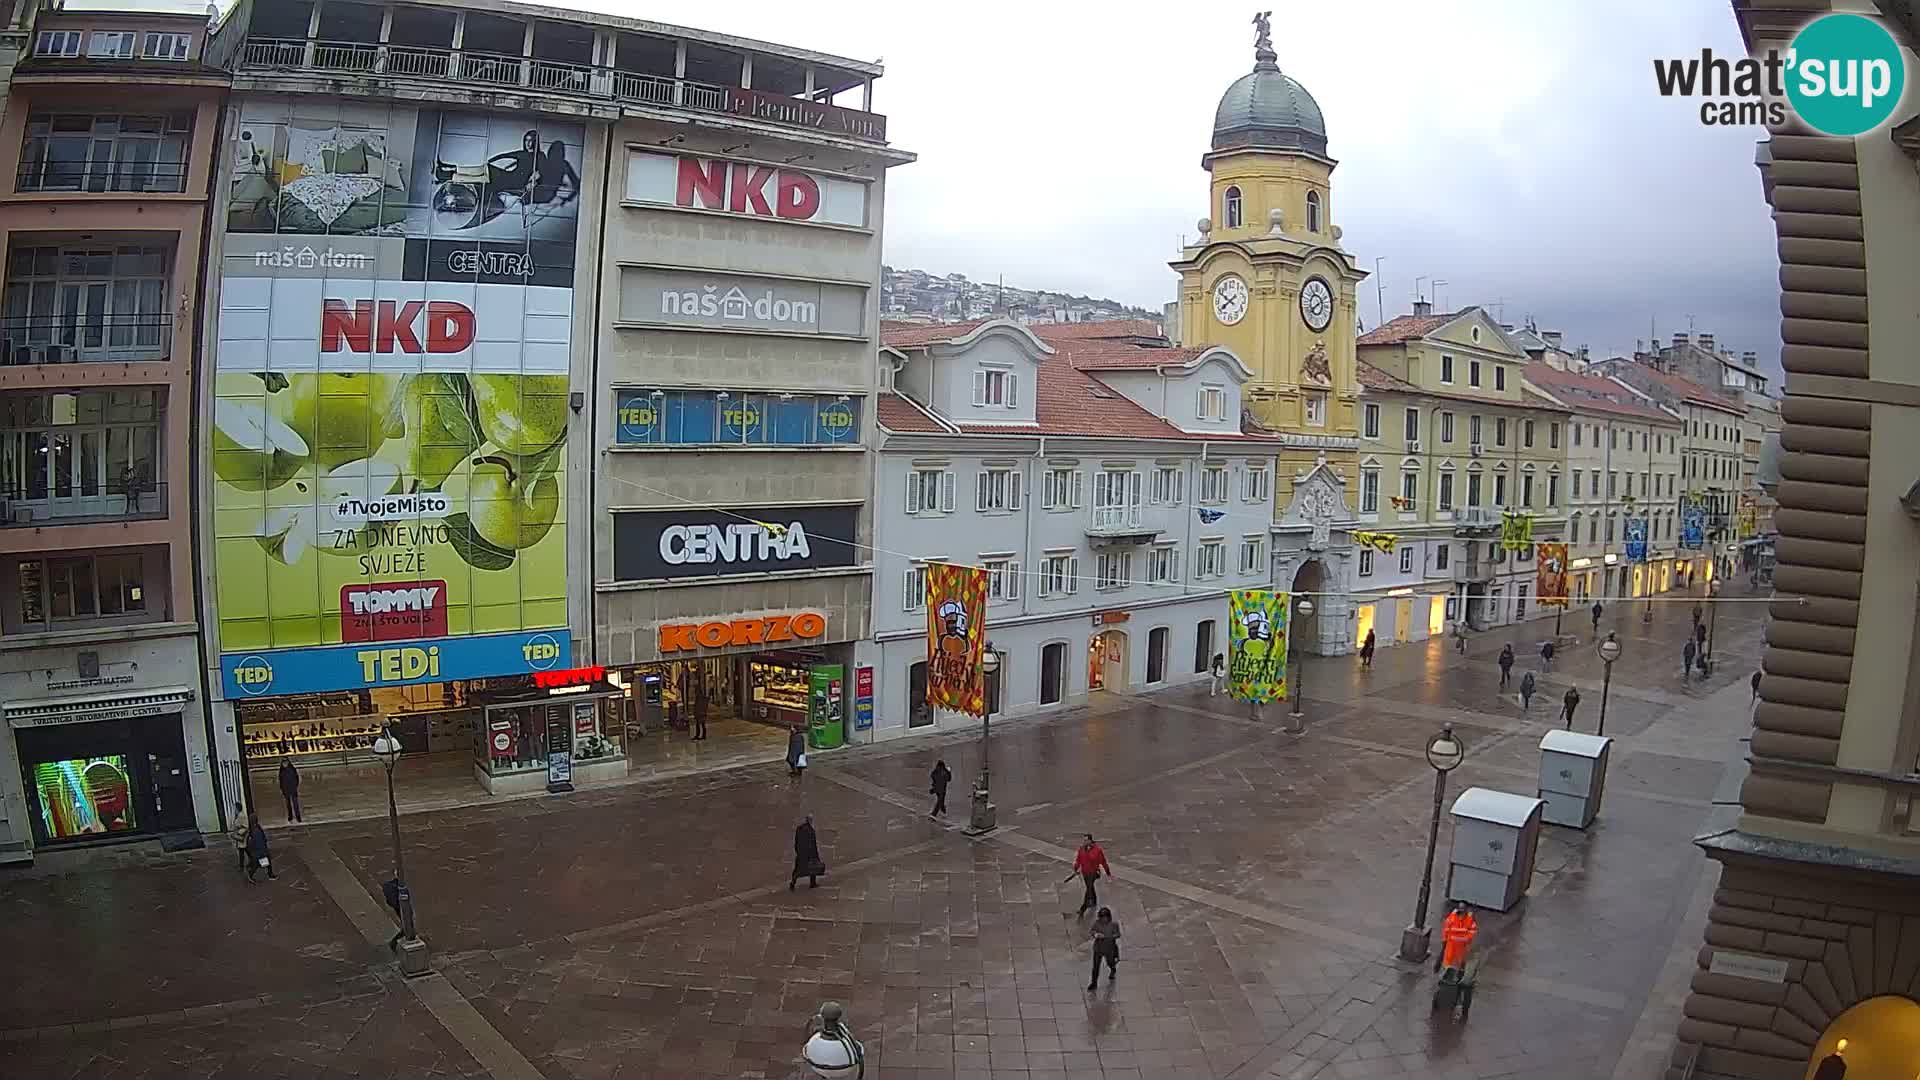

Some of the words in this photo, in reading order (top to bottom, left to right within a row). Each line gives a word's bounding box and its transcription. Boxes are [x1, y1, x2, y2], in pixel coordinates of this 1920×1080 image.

[676, 158, 821, 221] NKD
[255, 247, 293, 268] naš
[319, 248, 366, 269] dom
[448, 250, 534, 276] CENTRA
[661, 285, 718, 317] naš
[753, 290, 816, 322] dom
[321, 298, 477, 354] NKD
[619, 408, 657, 425] TEDi
[723, 410, 760, 426] TEDi
[820, 412, 853, 427] TEDi
[339, 496, 446, 517] #TvojeMisto
[334, 529, 357, 549] ZA
[366, 525, 450, 548] DNEVNO
[659, 521, 811, 565] CENTRA
[360, 547, 427, 575] SVJEŽE
[349, 586, 440, 615] TOMMY
[659, 612, 826, 653] KORZO
[357, 646, 440, 683] TEDi
[523, 643, 560, 661] TEDi
[234, 666, 273, 685] TEDi
